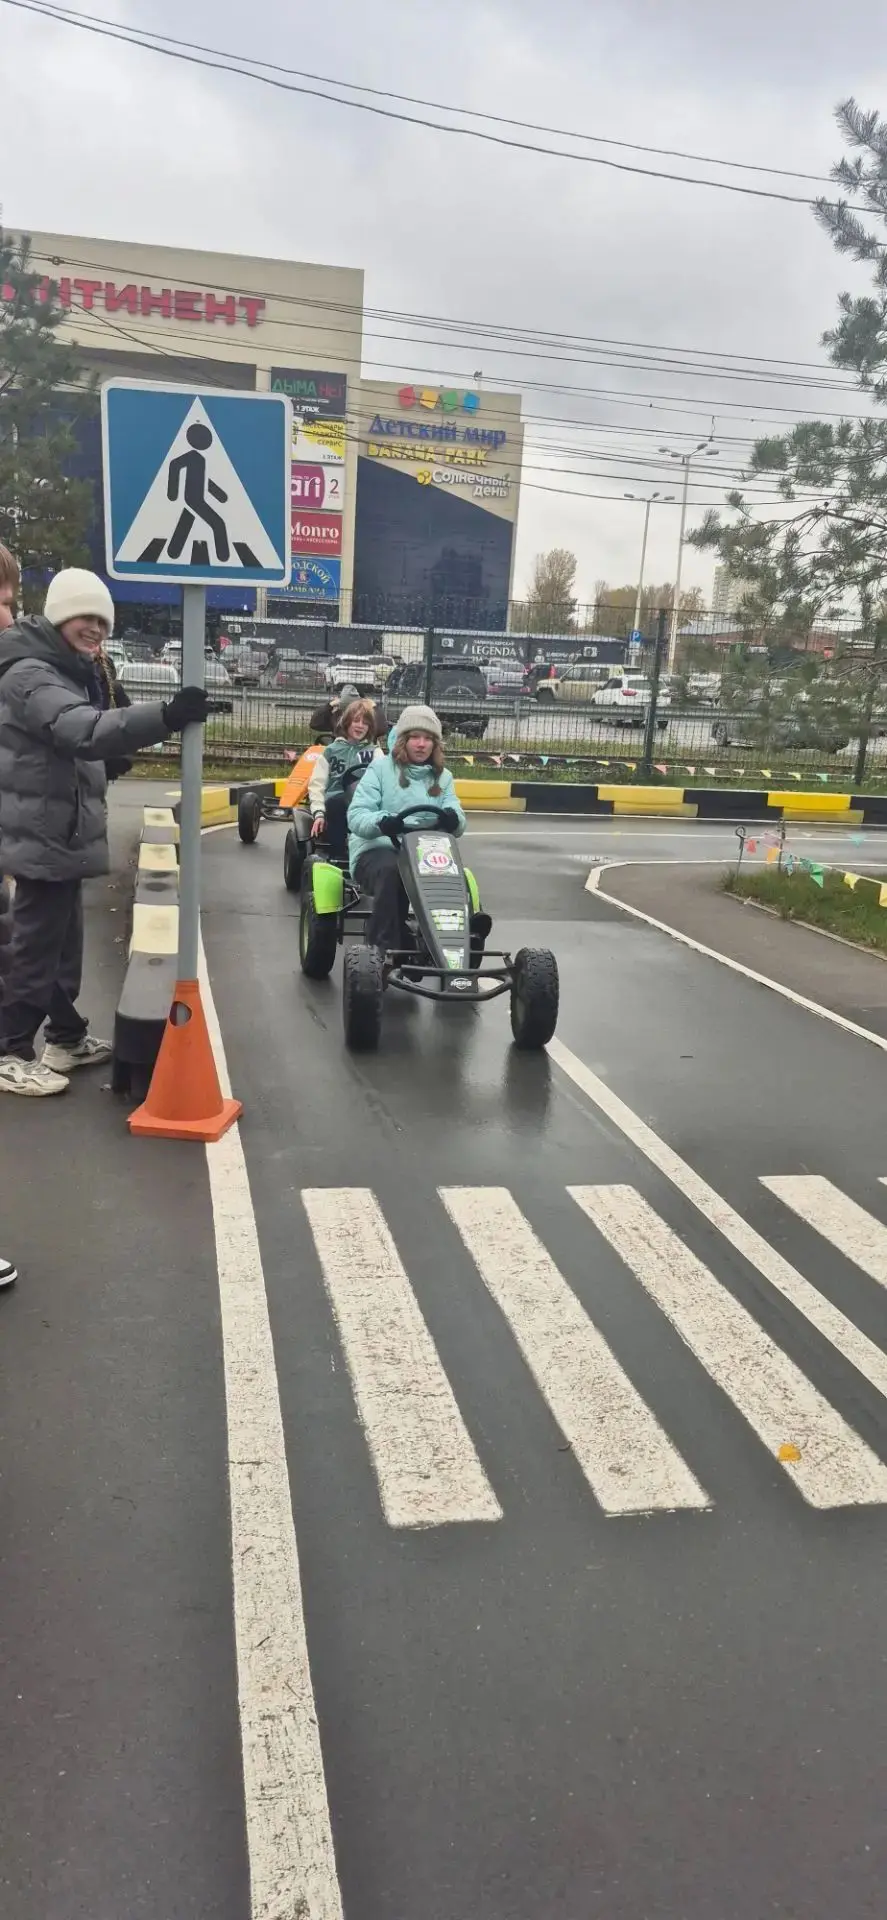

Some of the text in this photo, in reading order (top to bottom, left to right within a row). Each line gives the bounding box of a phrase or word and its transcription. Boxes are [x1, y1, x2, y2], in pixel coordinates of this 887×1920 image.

[329, 478, 339, 494] 2
[432, 469, 512, 488] Солнечный
[291, 477, 320, 498] ari
[473, 485, 507, 497] день
[292, 560, 330, 584] ОДСКОЙ
[471, 645, 517, 657] LEGENDA
[330, 750, 374, 774] 26 W
[431, 855, 448, 865] 40
